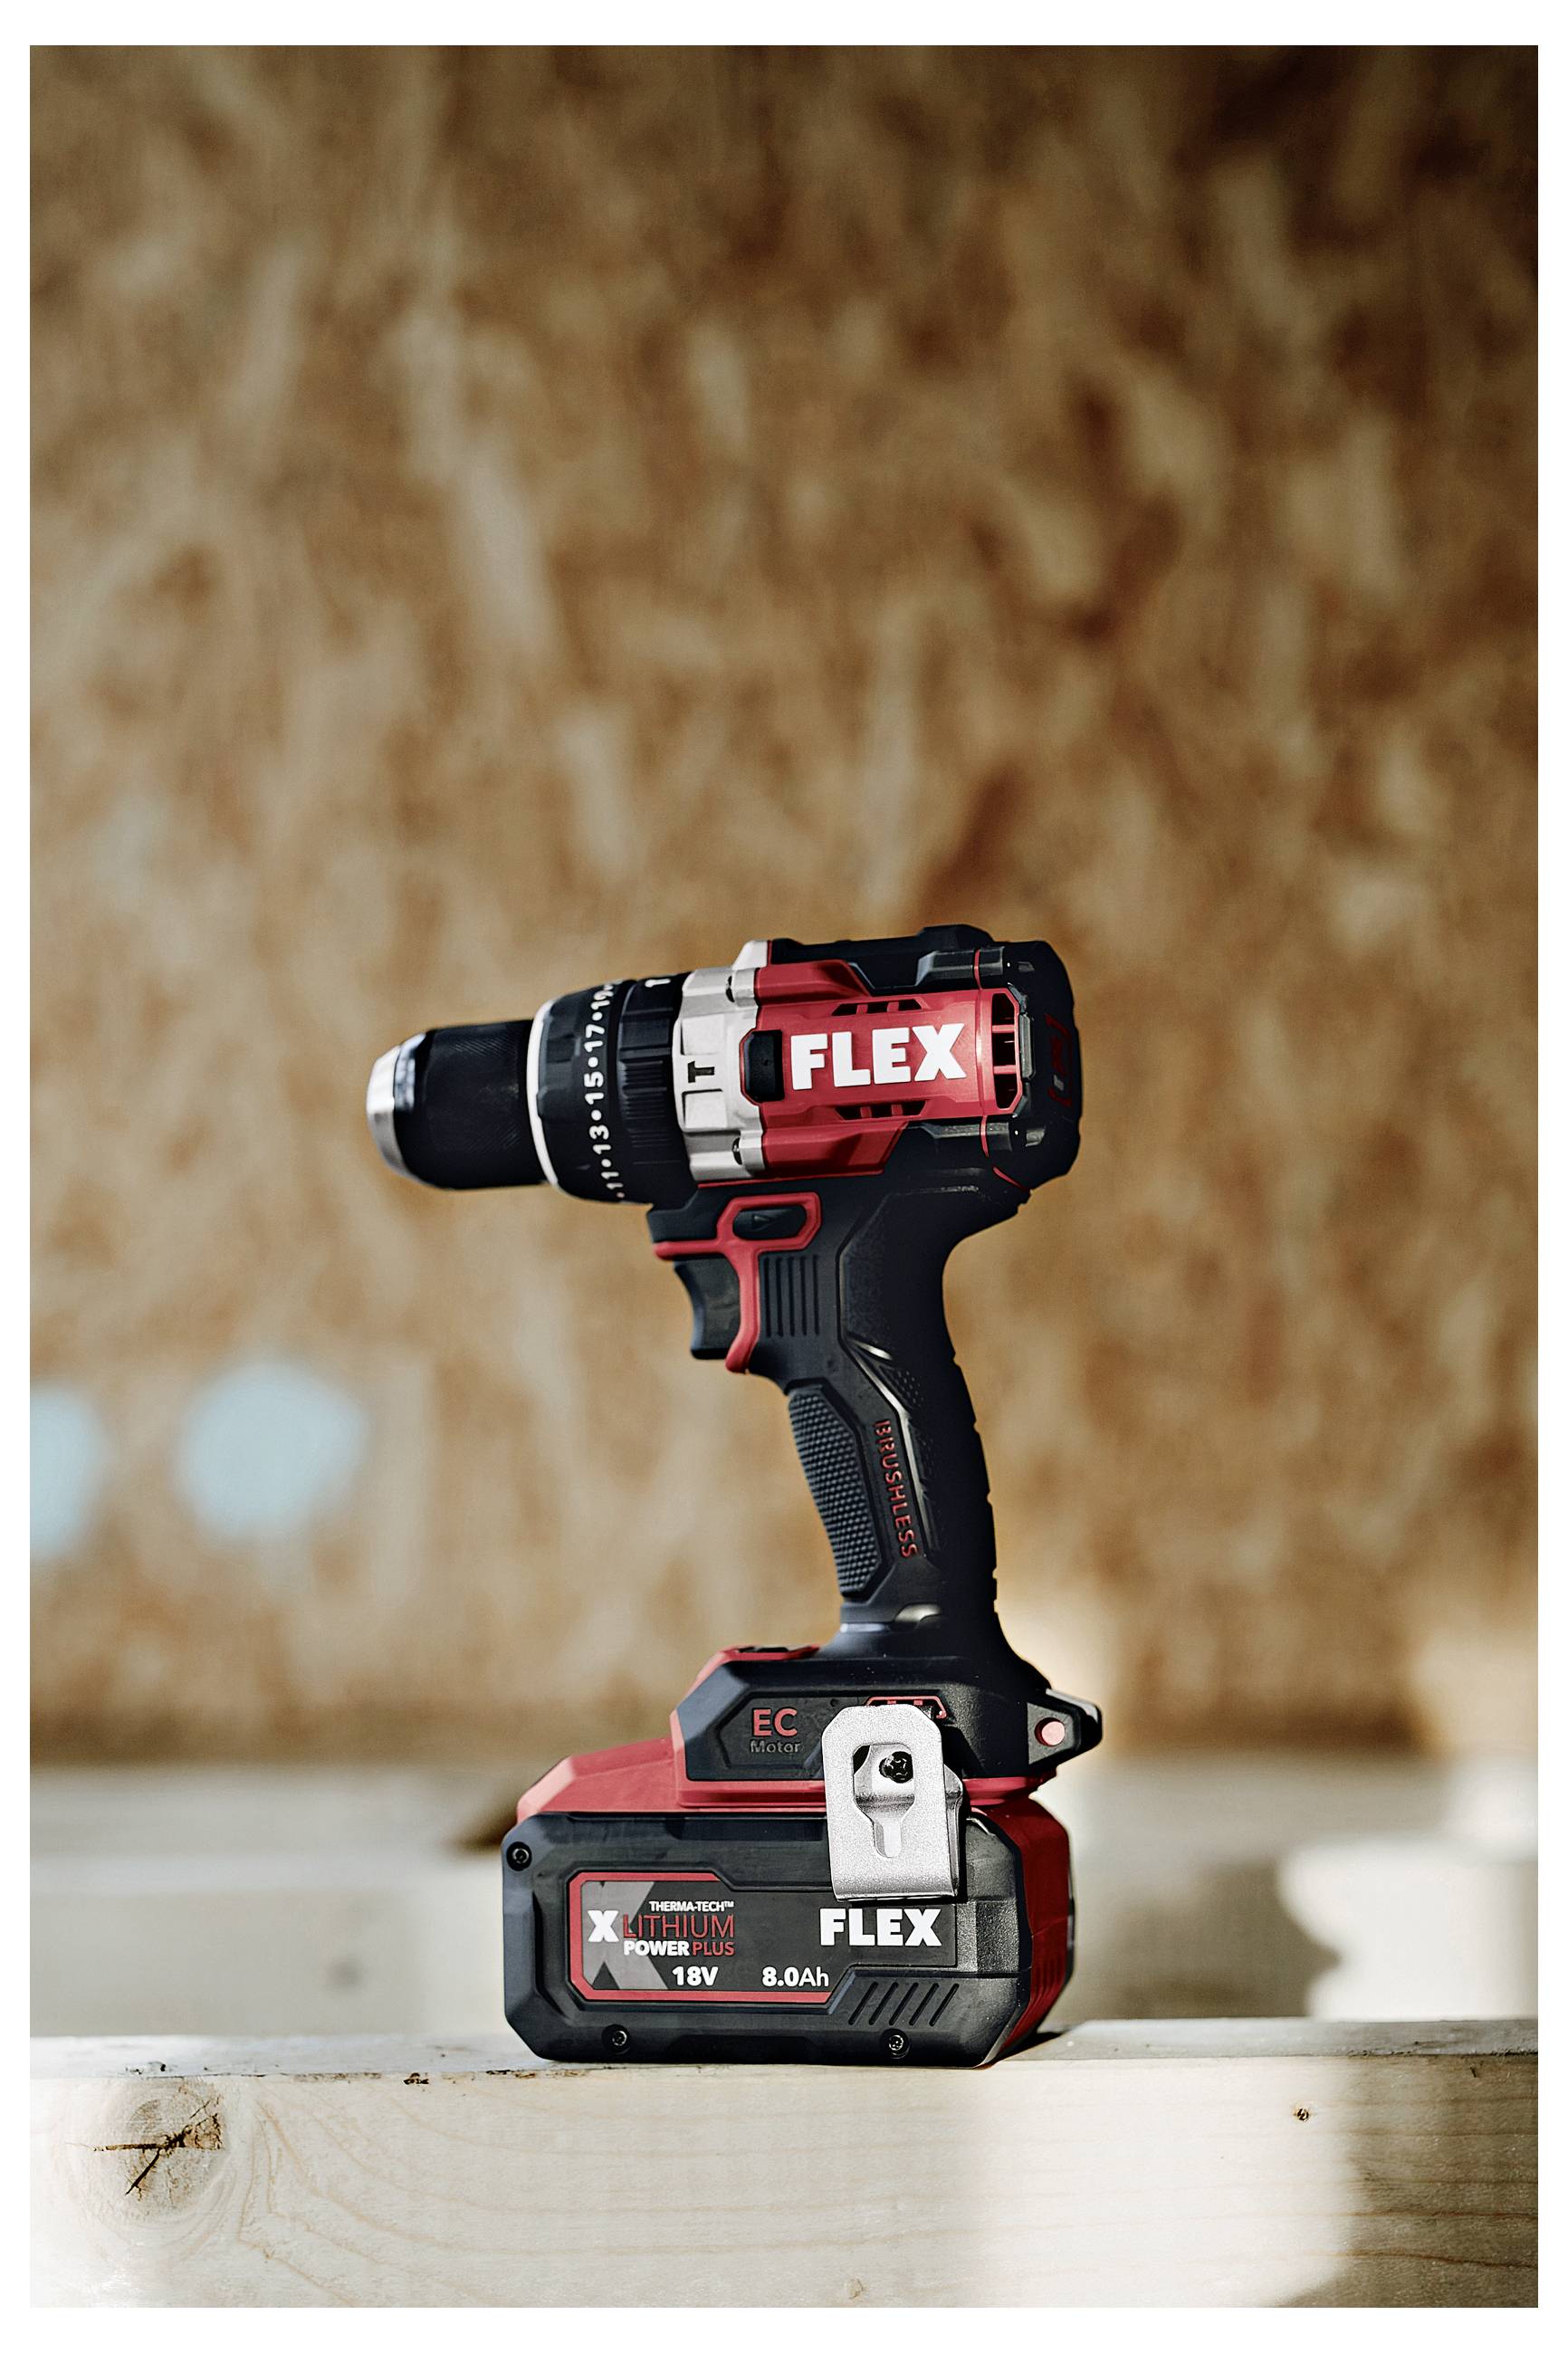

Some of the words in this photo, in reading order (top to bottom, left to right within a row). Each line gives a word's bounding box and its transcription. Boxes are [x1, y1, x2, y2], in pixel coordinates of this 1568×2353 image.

[584, 1023, 606, 1052] 17
[790, 1023, 967, 1090] FLEX
[583, 1071, 605, 1105] 15
[588, 1124, 611, 1154] 13
[875, 1420, 919, 1558] BRUSHLESS
[753, 1708, 798, 1736] EC
[750, 1740, 802, 1753] Motor
[588, 1909, 619, 1943] X
[623, 1914, 735, 1938] LITHIUM
[819, 1908, 942, 1946] FLEX
[623, 1940, 690, 1956] POWER
[693, 1941, 735, 1956] PLUS
[672, 1966, 719, 1986] 18V
[761, 1966, 829, 1987] 8.0Ah
